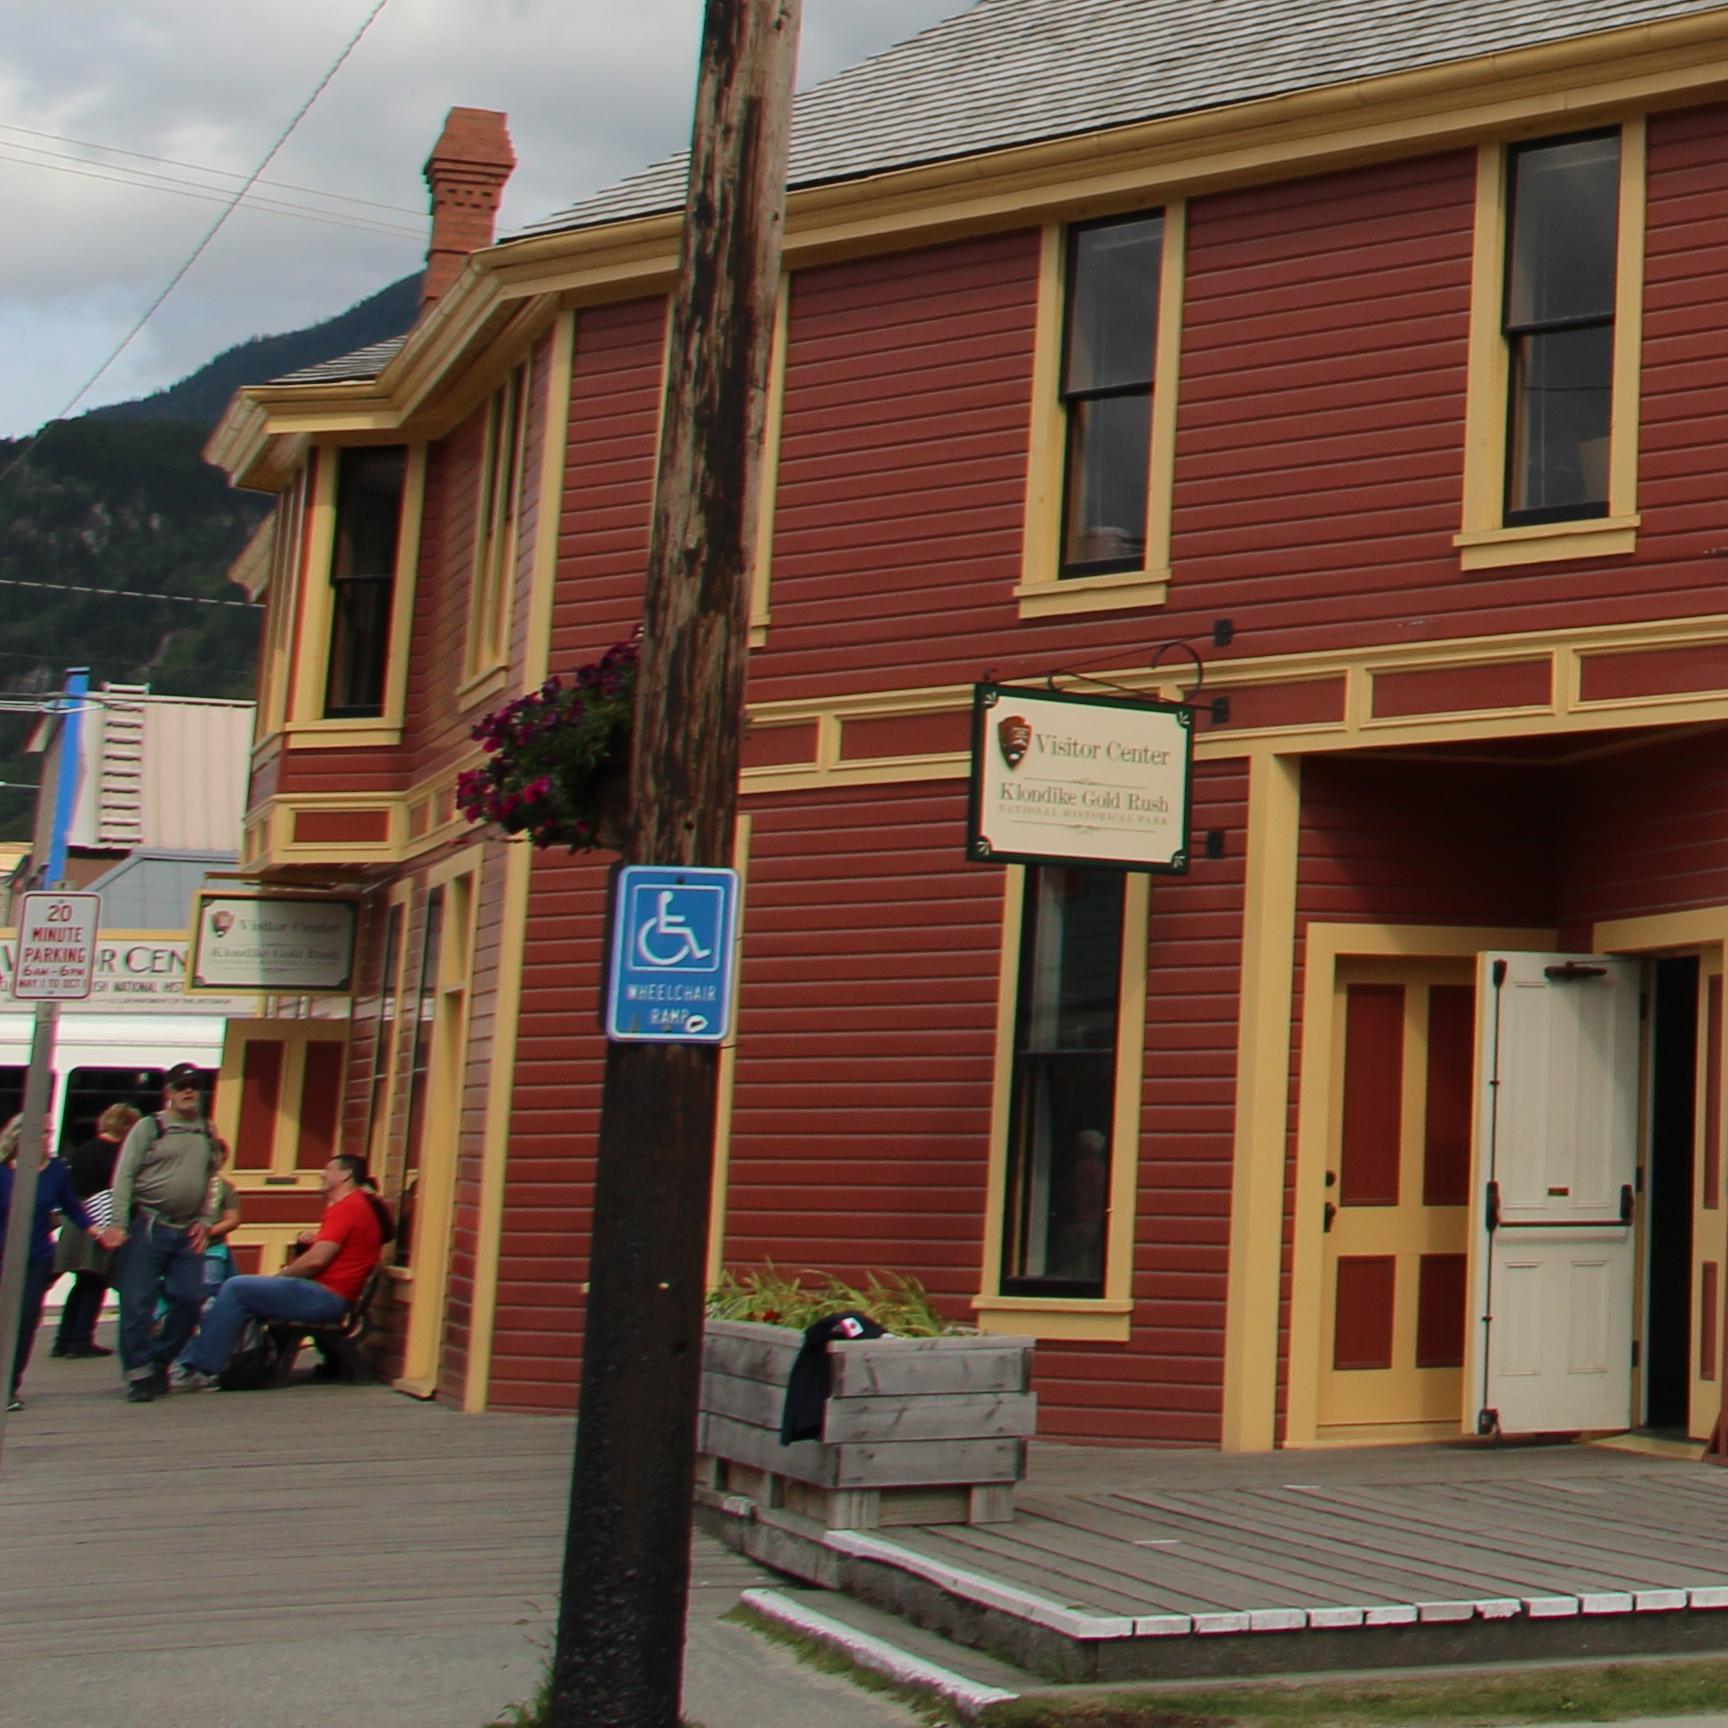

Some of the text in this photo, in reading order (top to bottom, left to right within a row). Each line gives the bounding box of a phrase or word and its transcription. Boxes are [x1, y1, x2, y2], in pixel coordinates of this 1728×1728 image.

[1035, 733, 1170, 765] Visitor Center
[999, 782, 1169, 813] Klondike Gold Rush
[48, 905, 72, 922] 20
[32, 927, 82, 942] MINUTE
[24, 947, 86, 963] PARKING
[626, 983, 717, 1001] WHEELCHAIR
[651, 1008, 689, 1024] RAMP
